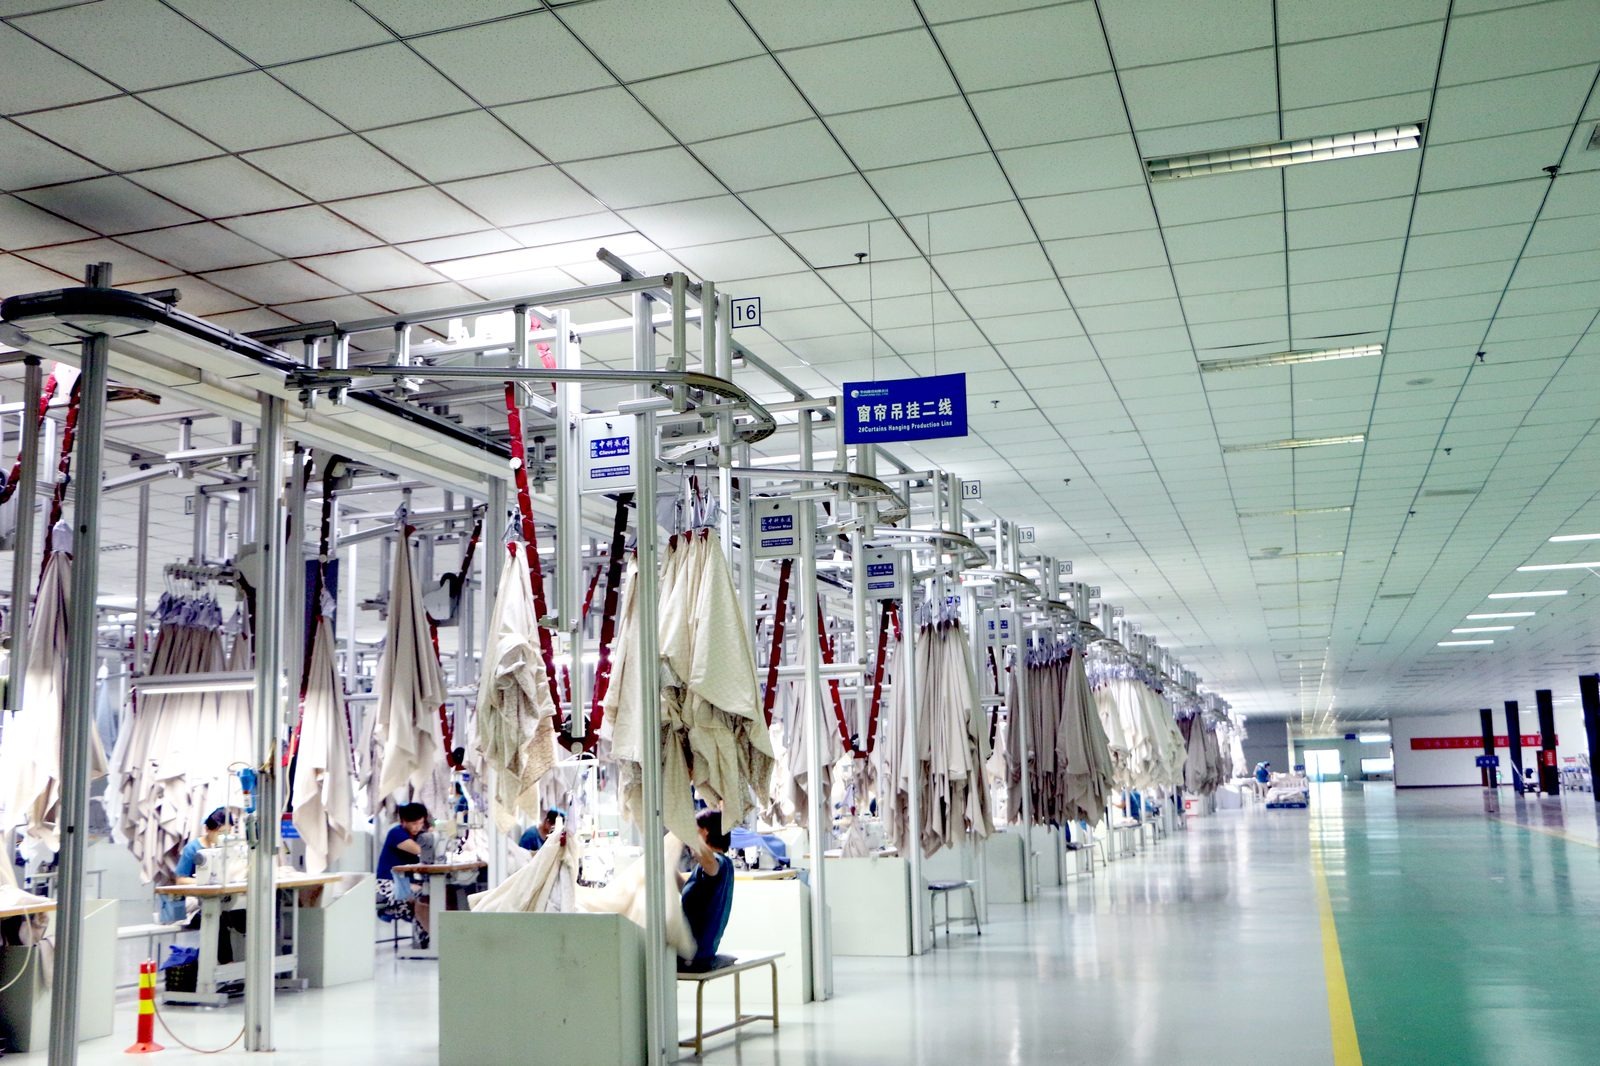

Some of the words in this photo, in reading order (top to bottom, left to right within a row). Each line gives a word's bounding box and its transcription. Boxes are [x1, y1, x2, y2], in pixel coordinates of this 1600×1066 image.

[736, 304, 756, 321] 16
[857, 398, 953, 423] 窗帘吊挂二线
[888, 424, 910, 432] Hanging
[911, 421, 940, 430] Production
[941, 419, 953, 427] Line
[965, 484, 978, 495] 18
[1021, 530, 1033, 540] 19
[1060, 564, 1071, 572] 20
[1090, 588, 1099, 596] 21
